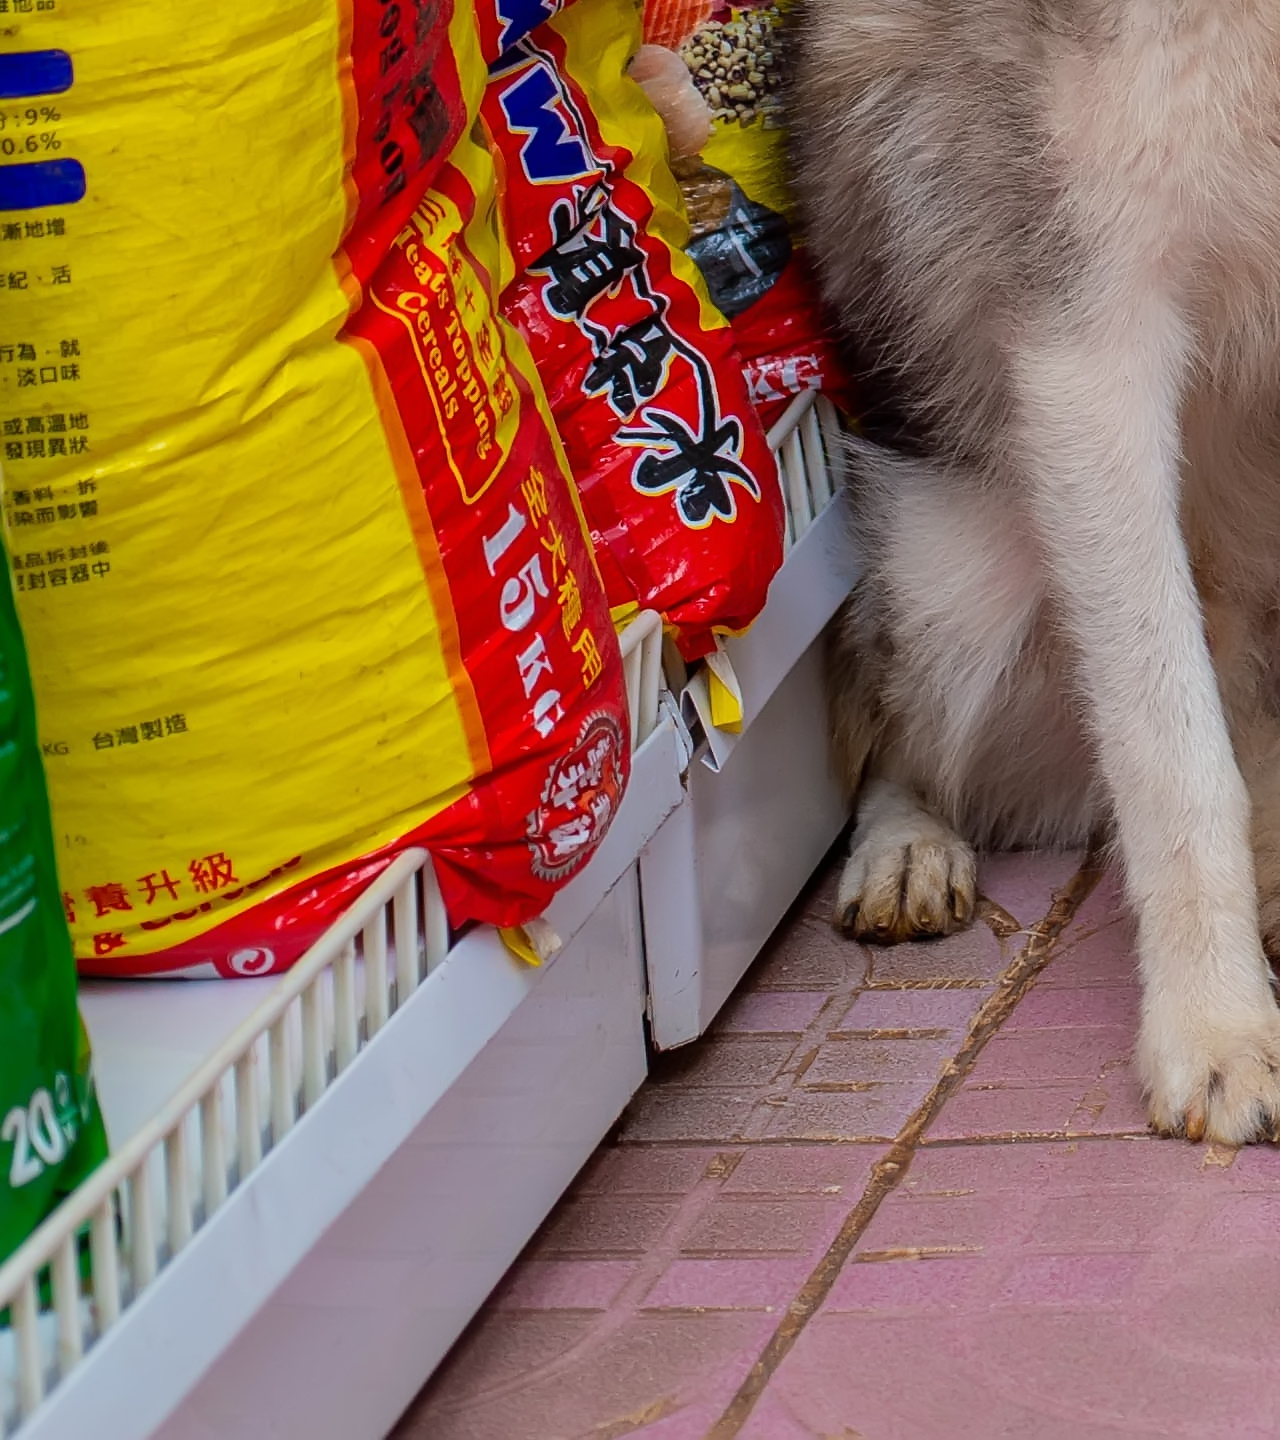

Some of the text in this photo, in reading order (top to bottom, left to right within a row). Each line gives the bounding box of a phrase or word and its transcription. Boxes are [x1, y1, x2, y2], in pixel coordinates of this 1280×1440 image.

[396, 289, 460, 422] Cereals
[443, 306, 493, 462] Topping
[92, 713, 189, 753] 台灣製造
